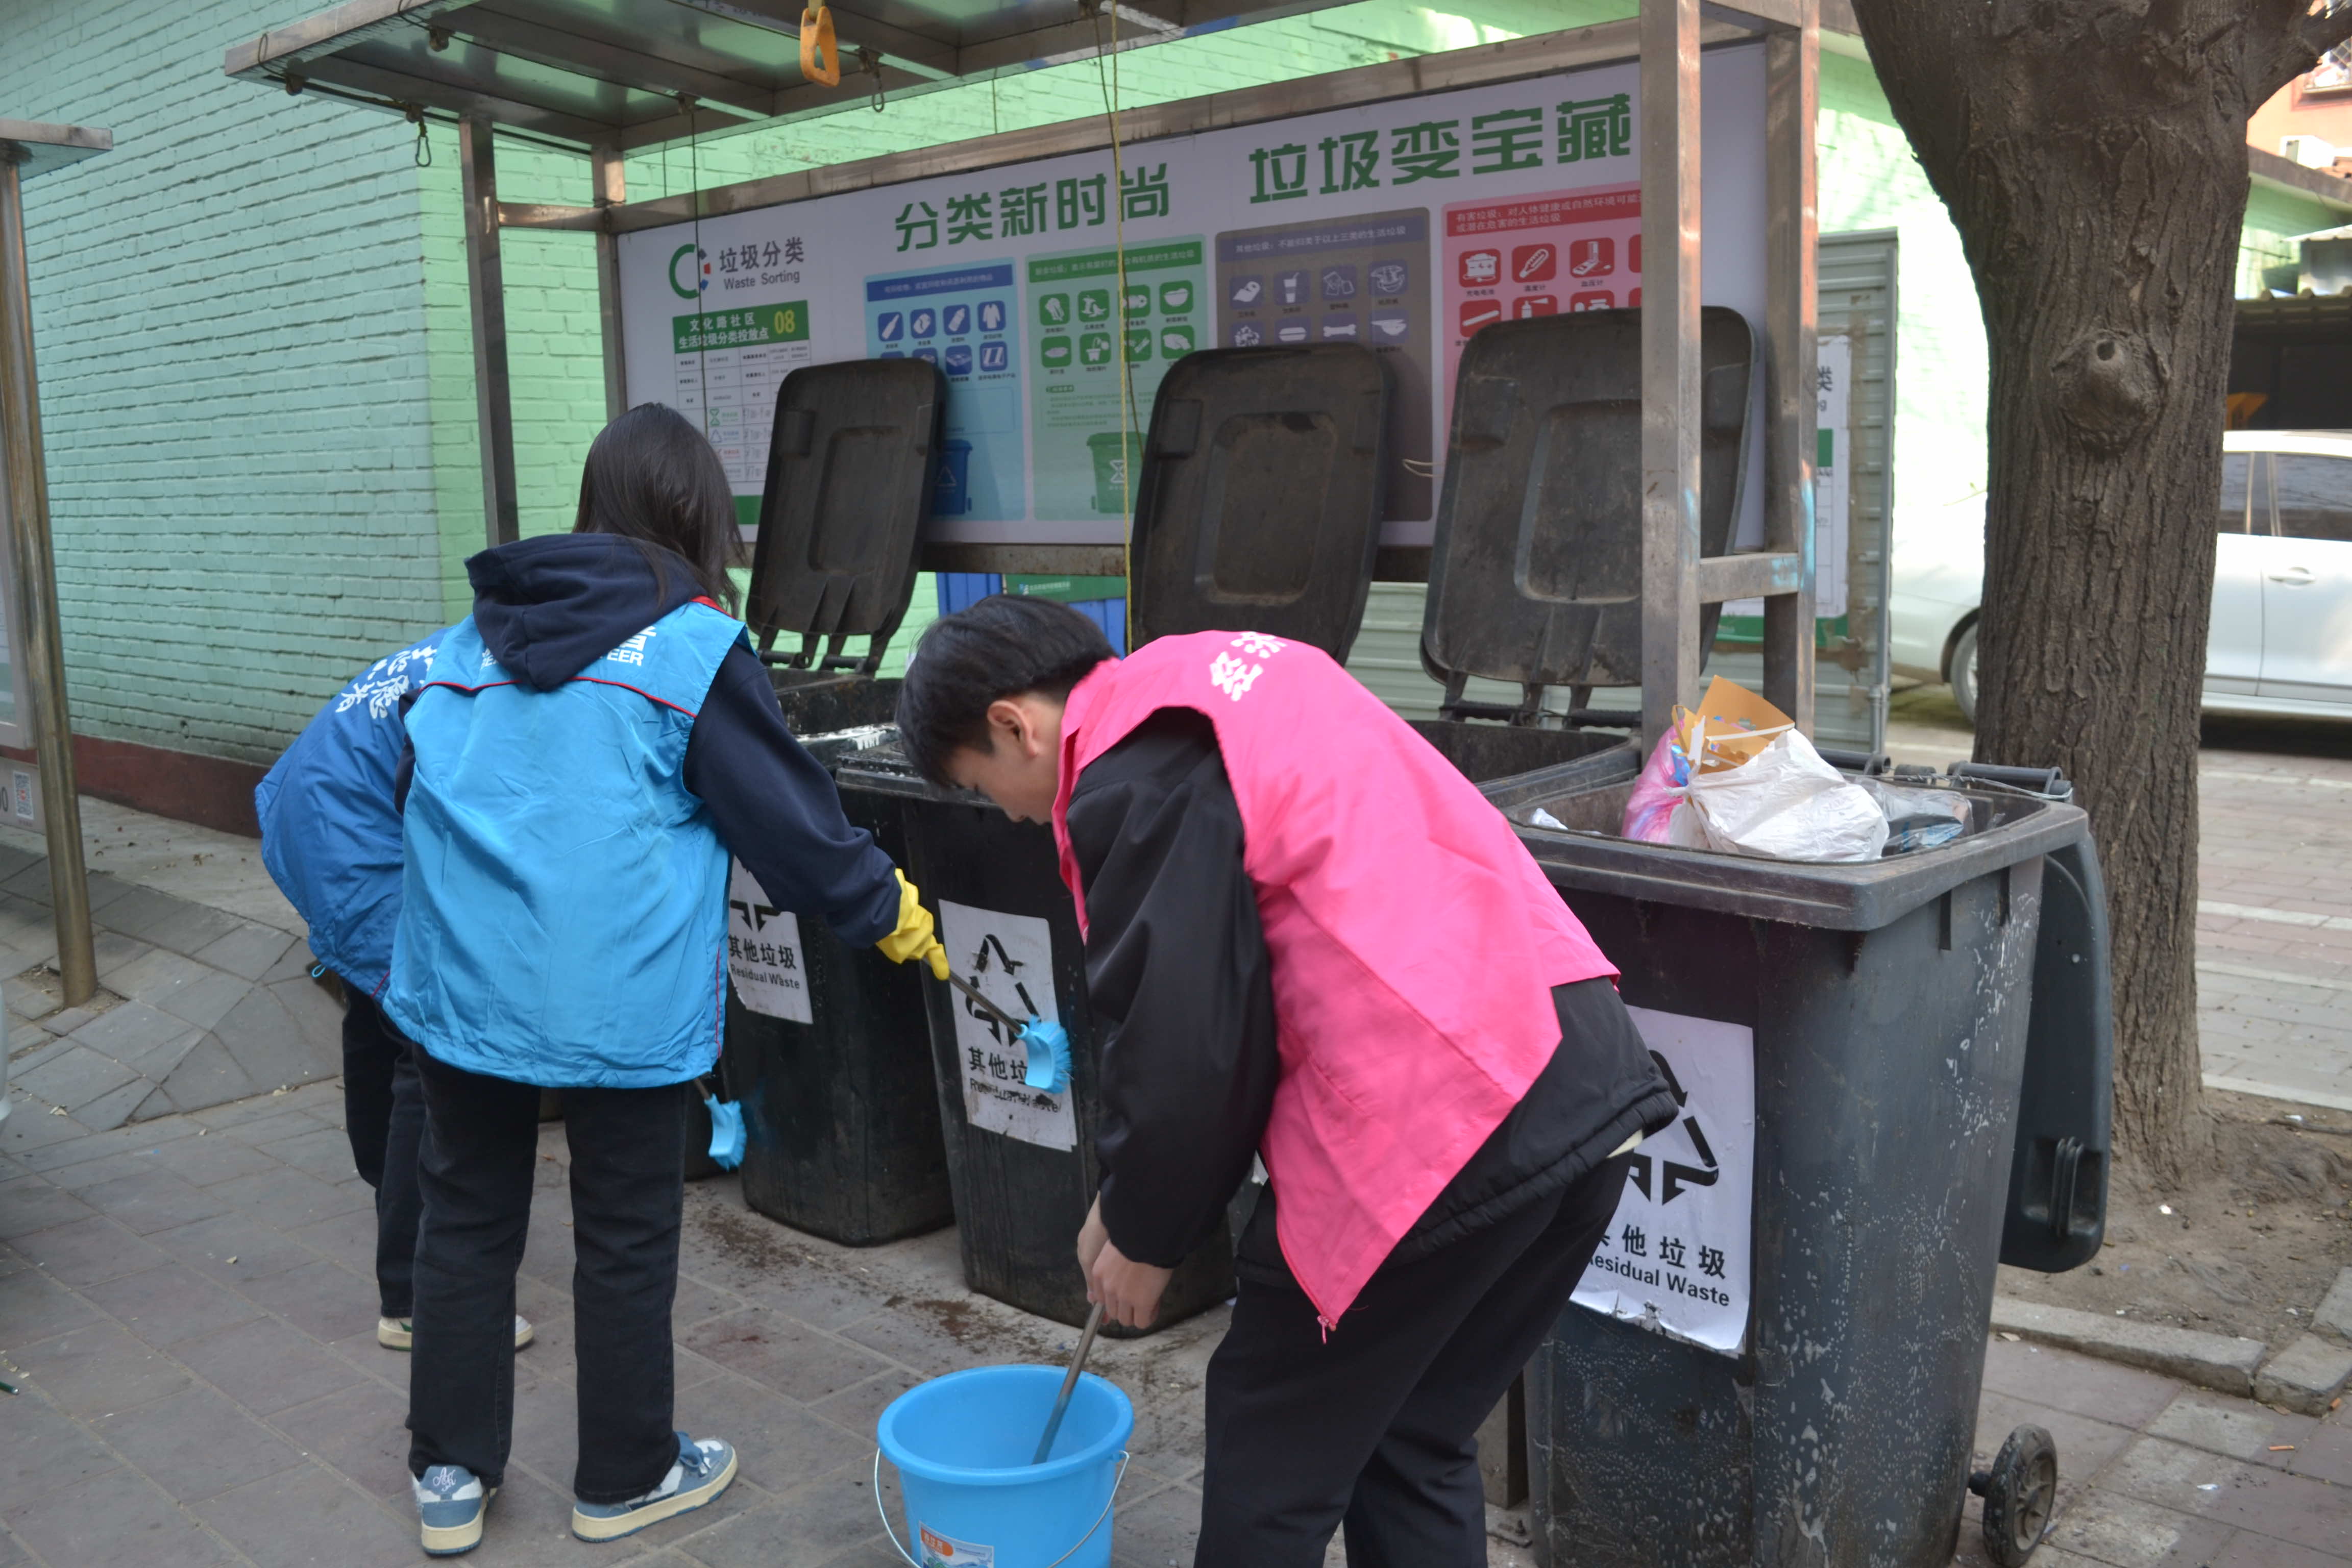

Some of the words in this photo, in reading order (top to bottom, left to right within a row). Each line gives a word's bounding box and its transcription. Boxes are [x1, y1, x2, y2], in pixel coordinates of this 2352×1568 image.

[895, 163, 1169, 252] 分类新时尚
[1249, 93, 1631, 204] 垃圾变宝藏
[719, 236, 804, 273] 垃圾分类
[724, 277, 756, 290] Waste
[761, 270, 800, 285] Sorting
[678, 327, 769, 349] 生活垃圾分类投放点
[690, 312, 755, 332] 文化路社区
[774, 309, 795, 335] 08
[728, 934, 797, 970] 其他垃圾
[731, 963, 768, 983] Residual
[768, 972, 800, 989] Waste
[968, 1046, 1028, 1085] 其他垃
[1600, 1223, 1727, 1280] 他垃圾
[1667, 1271, 1730, 1307] Waste
